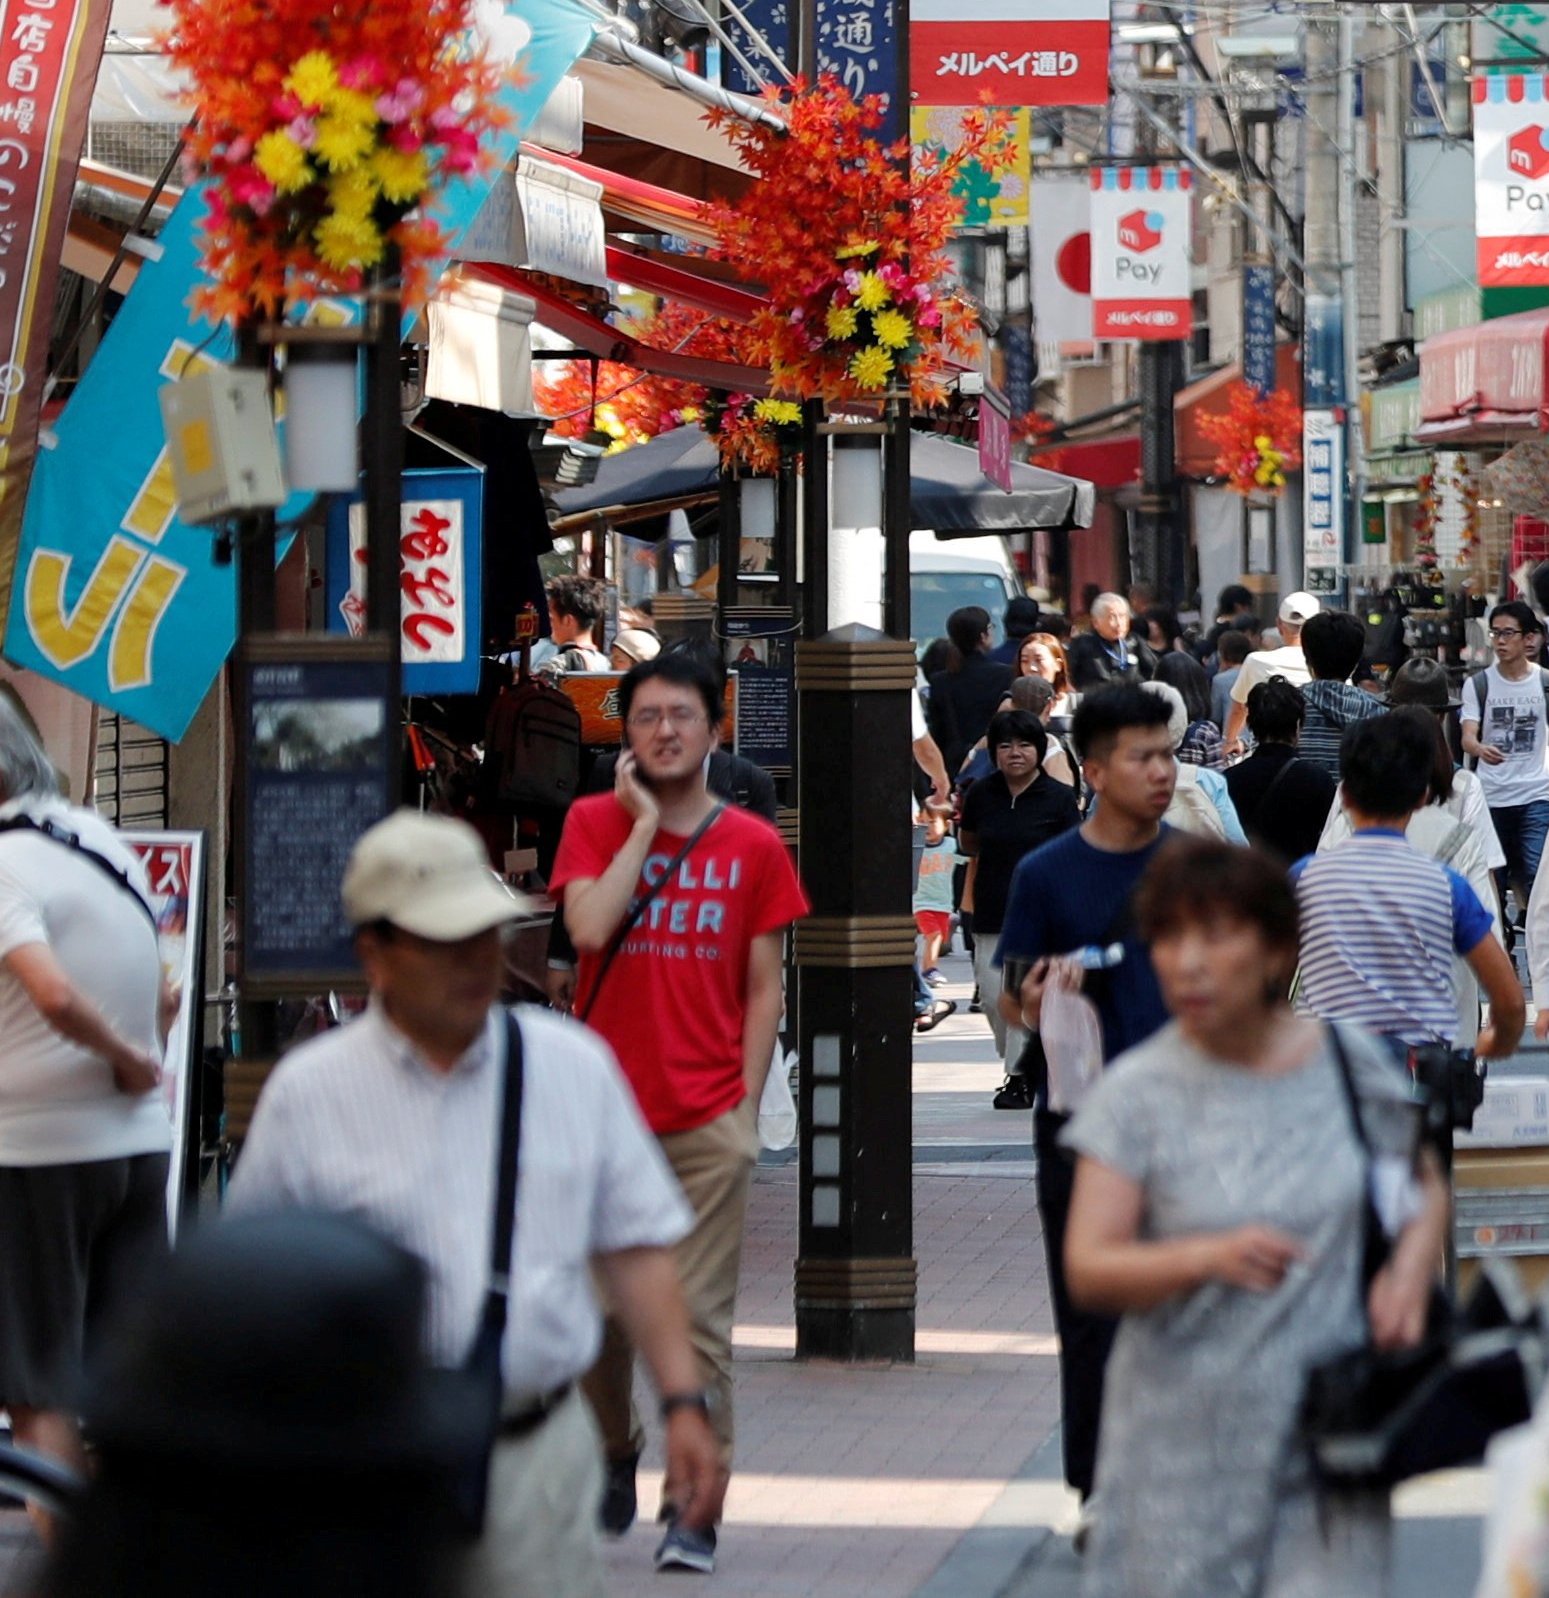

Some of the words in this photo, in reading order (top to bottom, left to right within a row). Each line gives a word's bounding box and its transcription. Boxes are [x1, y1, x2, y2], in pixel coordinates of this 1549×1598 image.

[936, 51, 1079, 77] メルペイ通り
[1115, 257, 1163, 285] Pay
